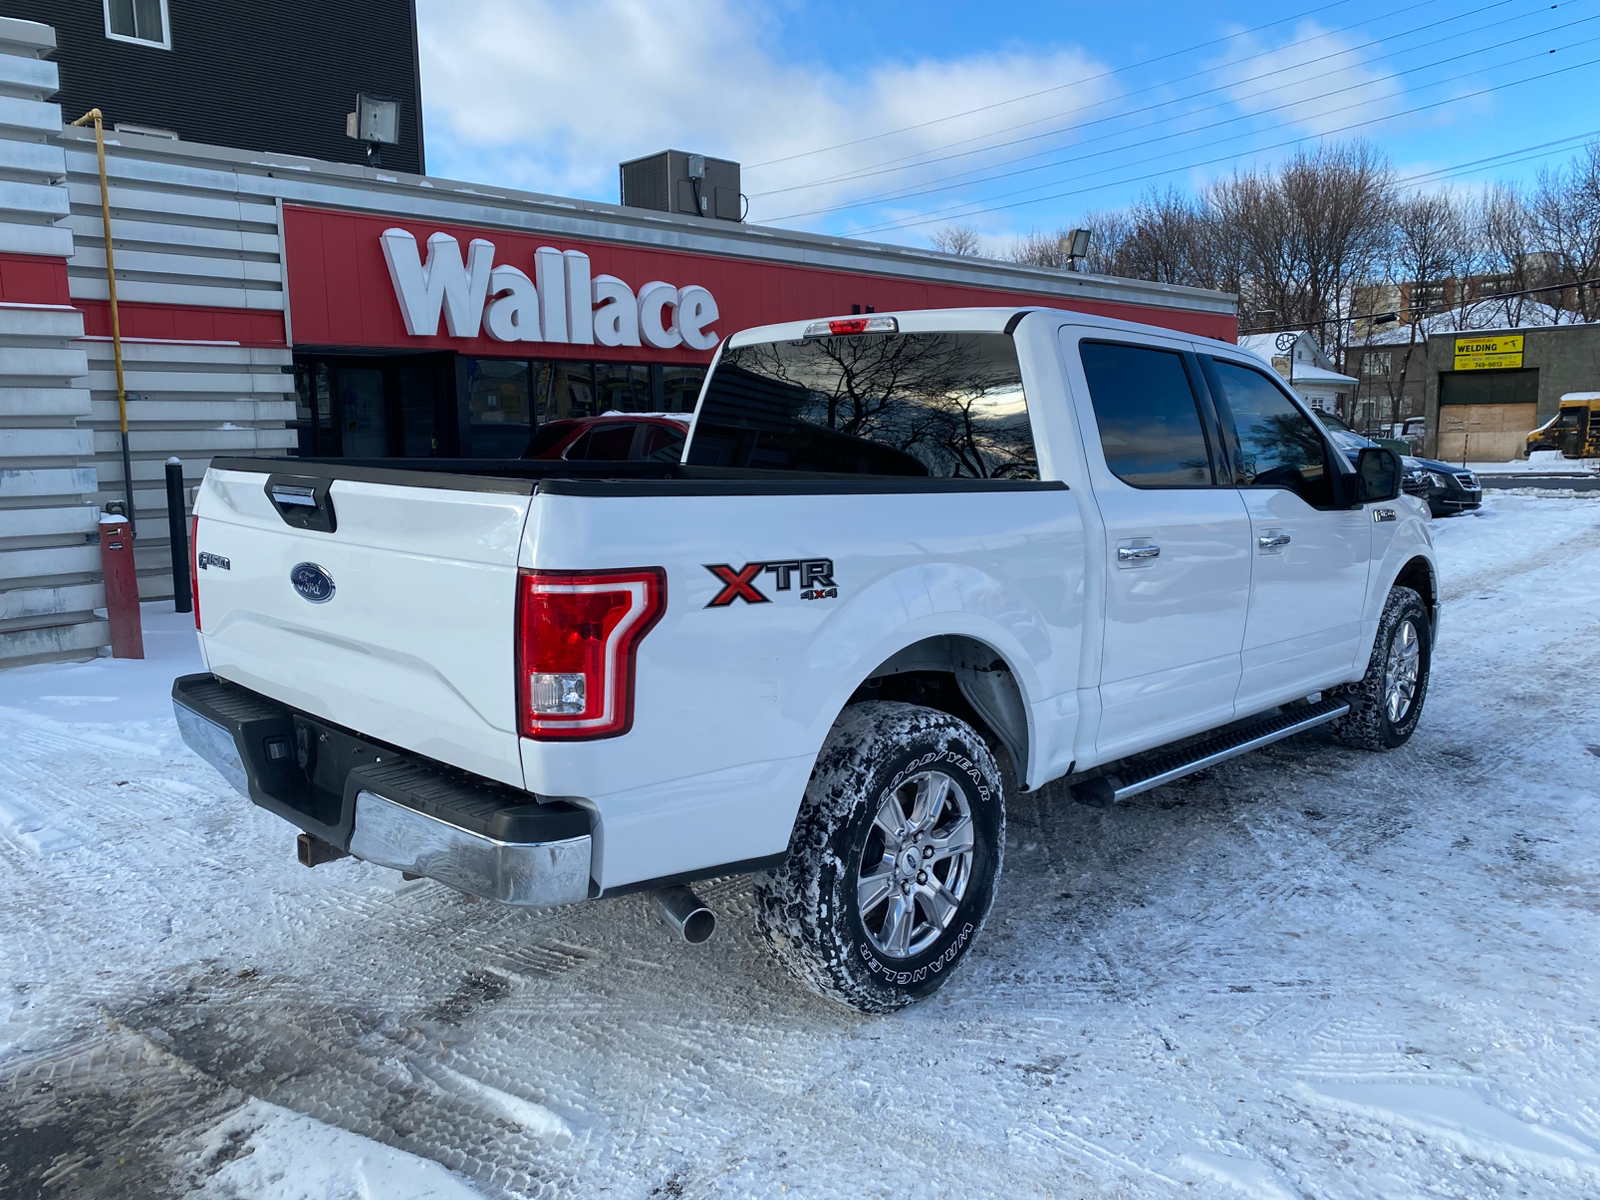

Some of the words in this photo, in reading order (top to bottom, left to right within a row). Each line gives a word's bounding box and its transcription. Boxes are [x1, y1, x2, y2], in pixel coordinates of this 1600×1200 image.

[379, 227, 721, 350] Wallace
[1457, 344, 1498, 353] WELDING
[298, 570, 322, 596] Ford
[700, 557, 839, 609] XTR
[876, 750, 990, 810] GOODYEAR
[860, 922, 974, 985] WRANGLER
